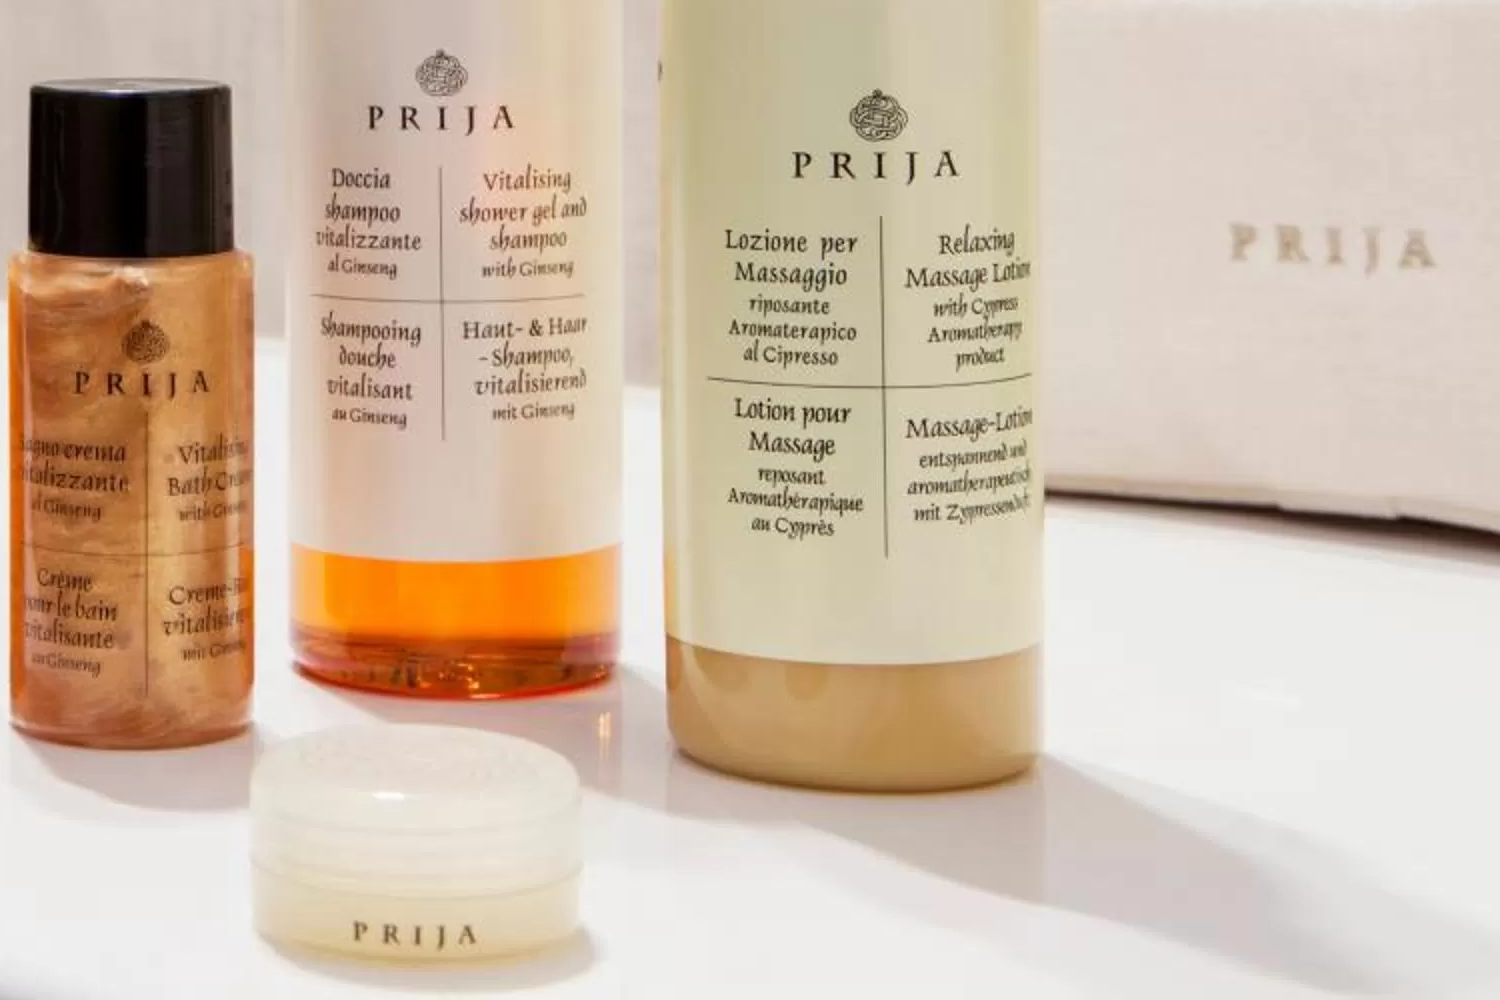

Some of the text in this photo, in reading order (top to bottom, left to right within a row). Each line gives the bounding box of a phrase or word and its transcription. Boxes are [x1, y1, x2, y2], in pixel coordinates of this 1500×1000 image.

[368, 105, 514, 136] PRIJA
[331, 167, 391, 189] Doccia
[483, 163, 571, 193] Vitalising
[792, 150, 960, 185] PRIJA
[325, 194, 401, 229] shampoo
[459, 194, 587, 227] shower gel and
[316, 223, 421, 252] vitalizzante
[489, 224, 568, 254] shampoo
[725, 229, 858, 260] Lozione per
[938, 223, 1016, 257] Relaxing
[1229, 222, 1437, 278] PRIJA
[328, 253, 397, 280] al Ginseng
[481, 256, 574, 279] with Ginseng
[734, 262, 848, 292] Massaggio
[904, 267, 989, 293] Massage
[749, 294, 831, 317] riposante
[933, 292, 1019, 321] with Cypress
[321, 310, 421, 348] Shampooing
[462, 316, 588, 340] Haut- & Haar
[728, 319, 857, 344] Aromaterapico
[927, 316, 1023, 343] Aromatherapy
[339, 342, 396, 370] douche
[743, 340, 839, 369] al Cipresso
[956, 346, 1005, 374] product
[75, 370, 209, 400] PRIJA
[327, 373, 412, 400] vitalisant
[474, 368, 587, 396] vitalisierend
[332, 408, 407, 429] au Ginseng
[492, 402, 575, 421] mit Ginseng
[734, 398, 852, 428] Lotion pour
[748, 431, 836, 462] Massage
[919, 441, 1007, 472] entspannend
[758, 467, 826, 487] reposant
[913, 503, 940, 521] mit
[751, 517, 835, 541] au Cyprès
[75, 593, 118, 621] bain
[353, 921, 477, 950] PRIJA
